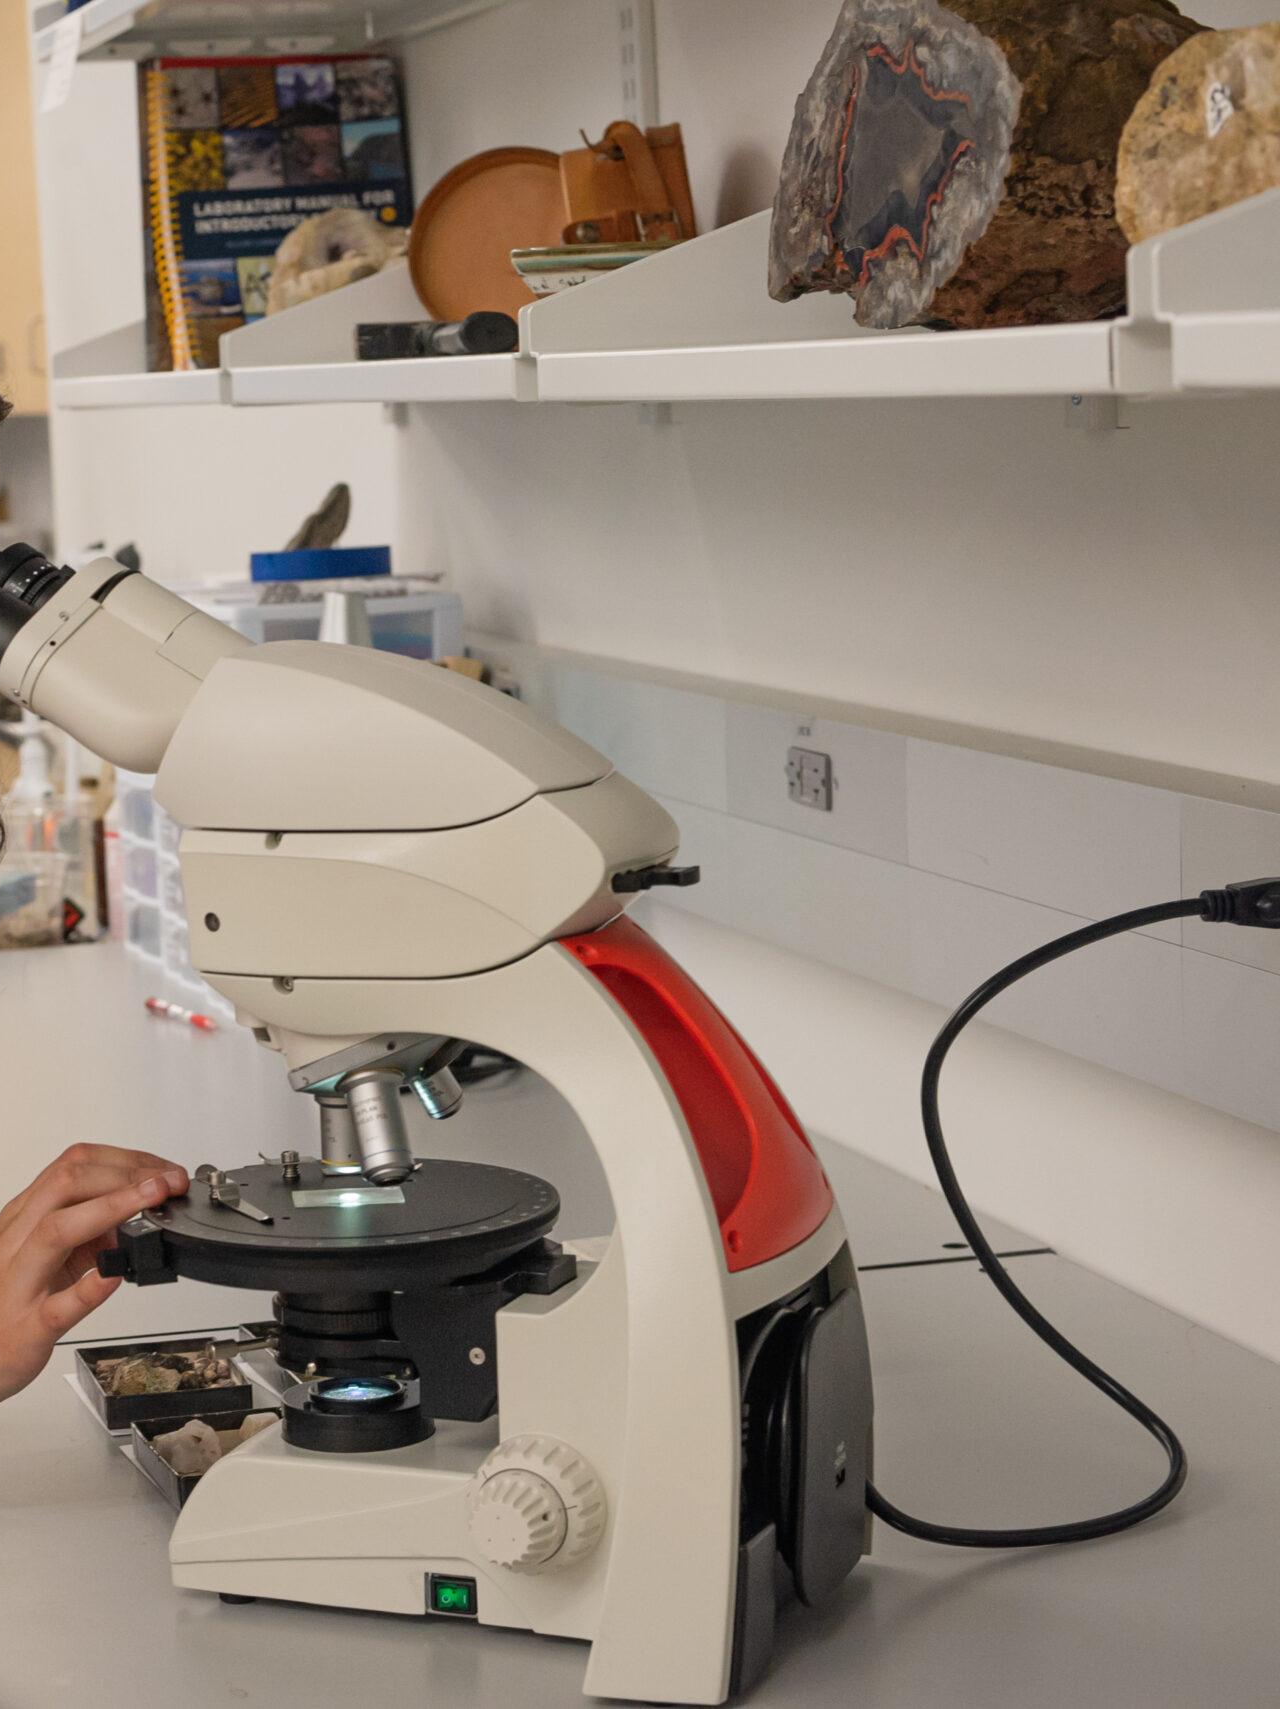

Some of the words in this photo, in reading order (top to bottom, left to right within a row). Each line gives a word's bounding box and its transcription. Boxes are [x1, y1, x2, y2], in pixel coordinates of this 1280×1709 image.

[193, 197, 292, 218] LABORATORY
[295, 194, 357, 211] MANUAL
[362, 189, 395, 206] FOR
